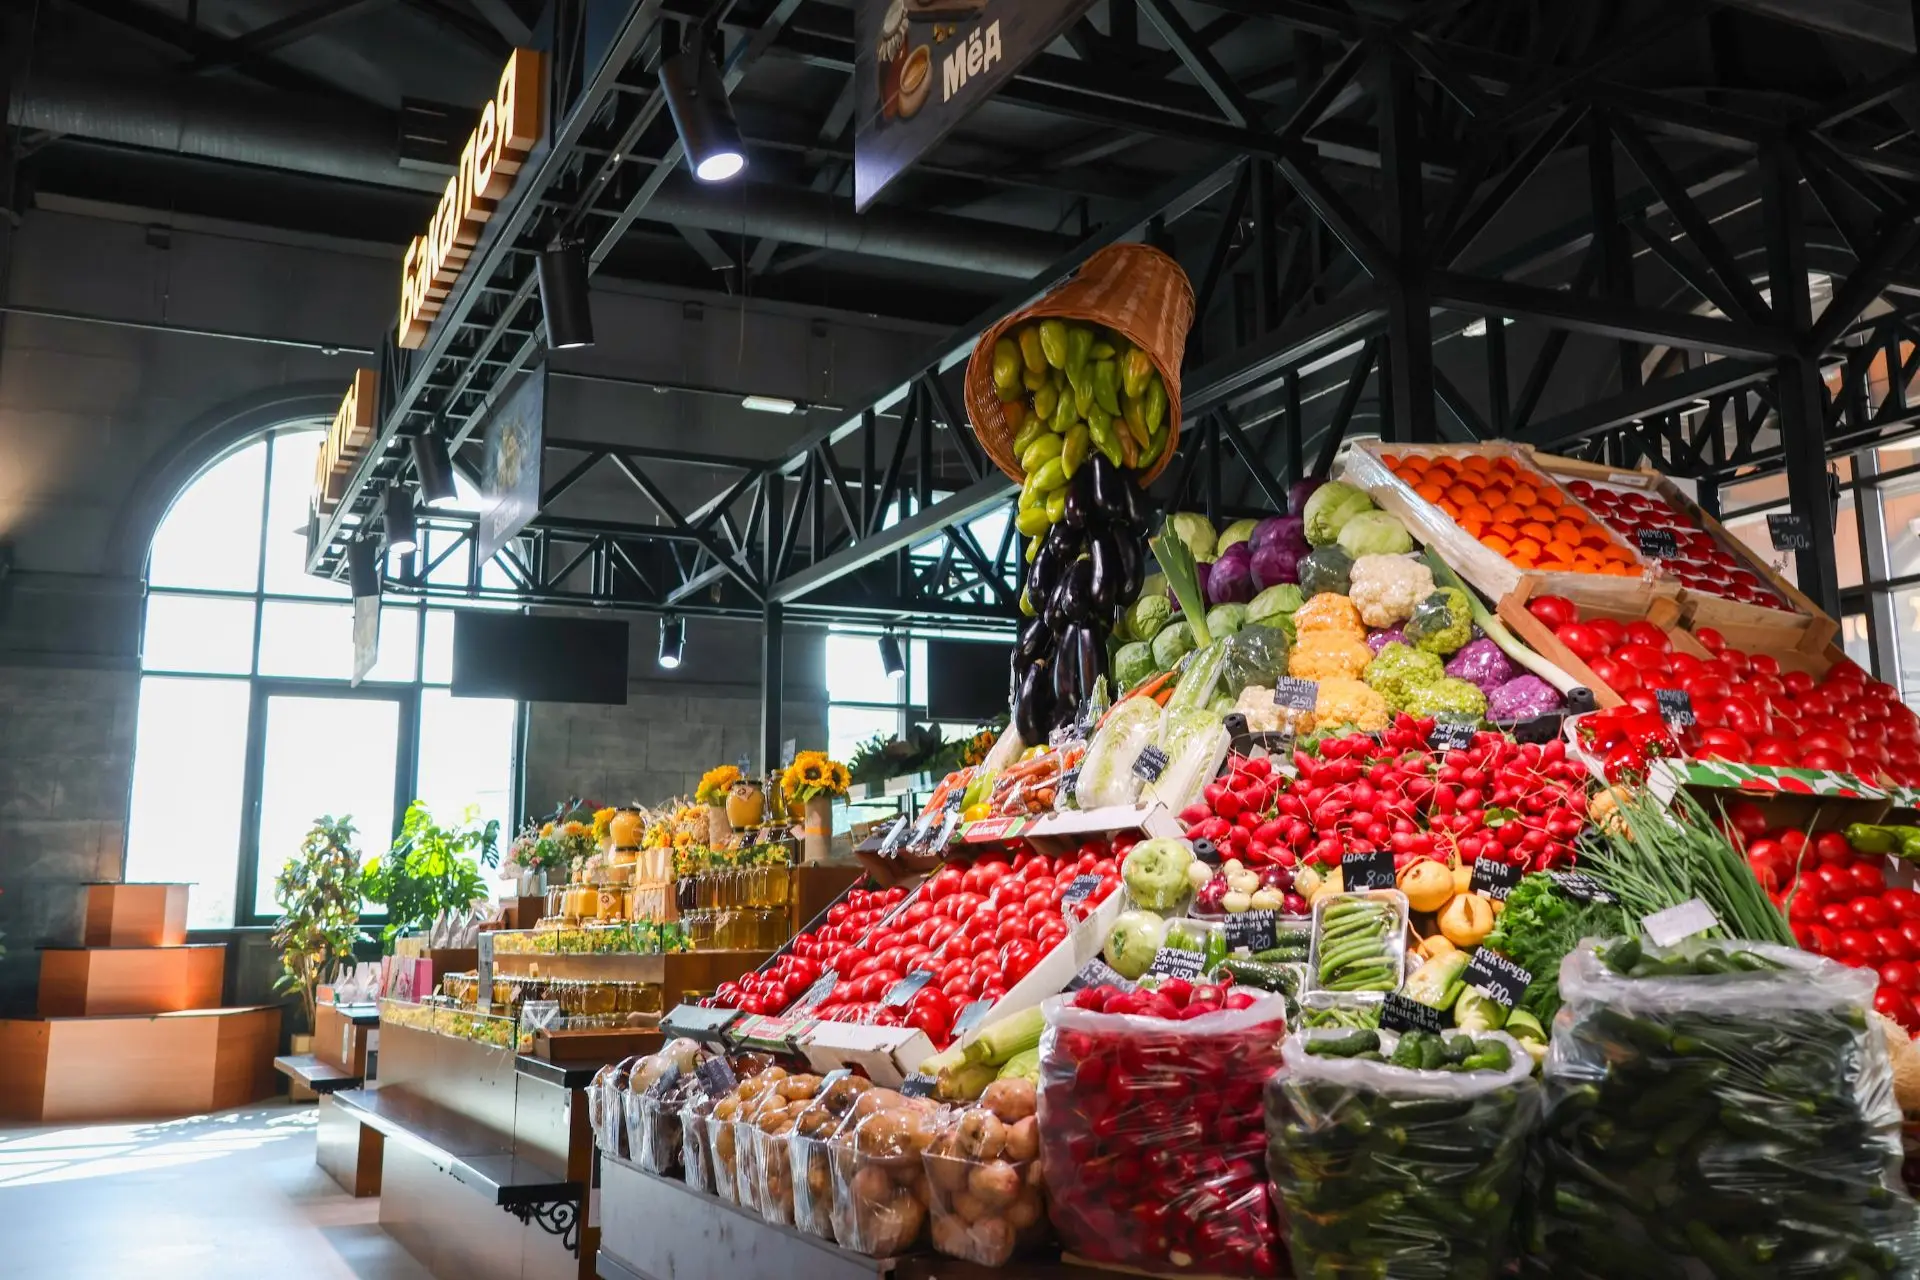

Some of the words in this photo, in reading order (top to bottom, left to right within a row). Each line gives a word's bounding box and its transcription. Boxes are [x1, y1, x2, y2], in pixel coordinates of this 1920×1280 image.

[943, 19, 1002, 103] Мёд
[398, 46, 518, 348] Бакалея
[1475, 856, 1509, 877] РЕПА
[1366, 870, 1395, 888] 800
[1247, 934, 1271, 950] 420
[1158, 947, 1207, 963] ОГУРЧИКИ
[1475, 946, 1532, 986] КУКУРУЗА
[1487, 980, 1513, 1006] 100р
